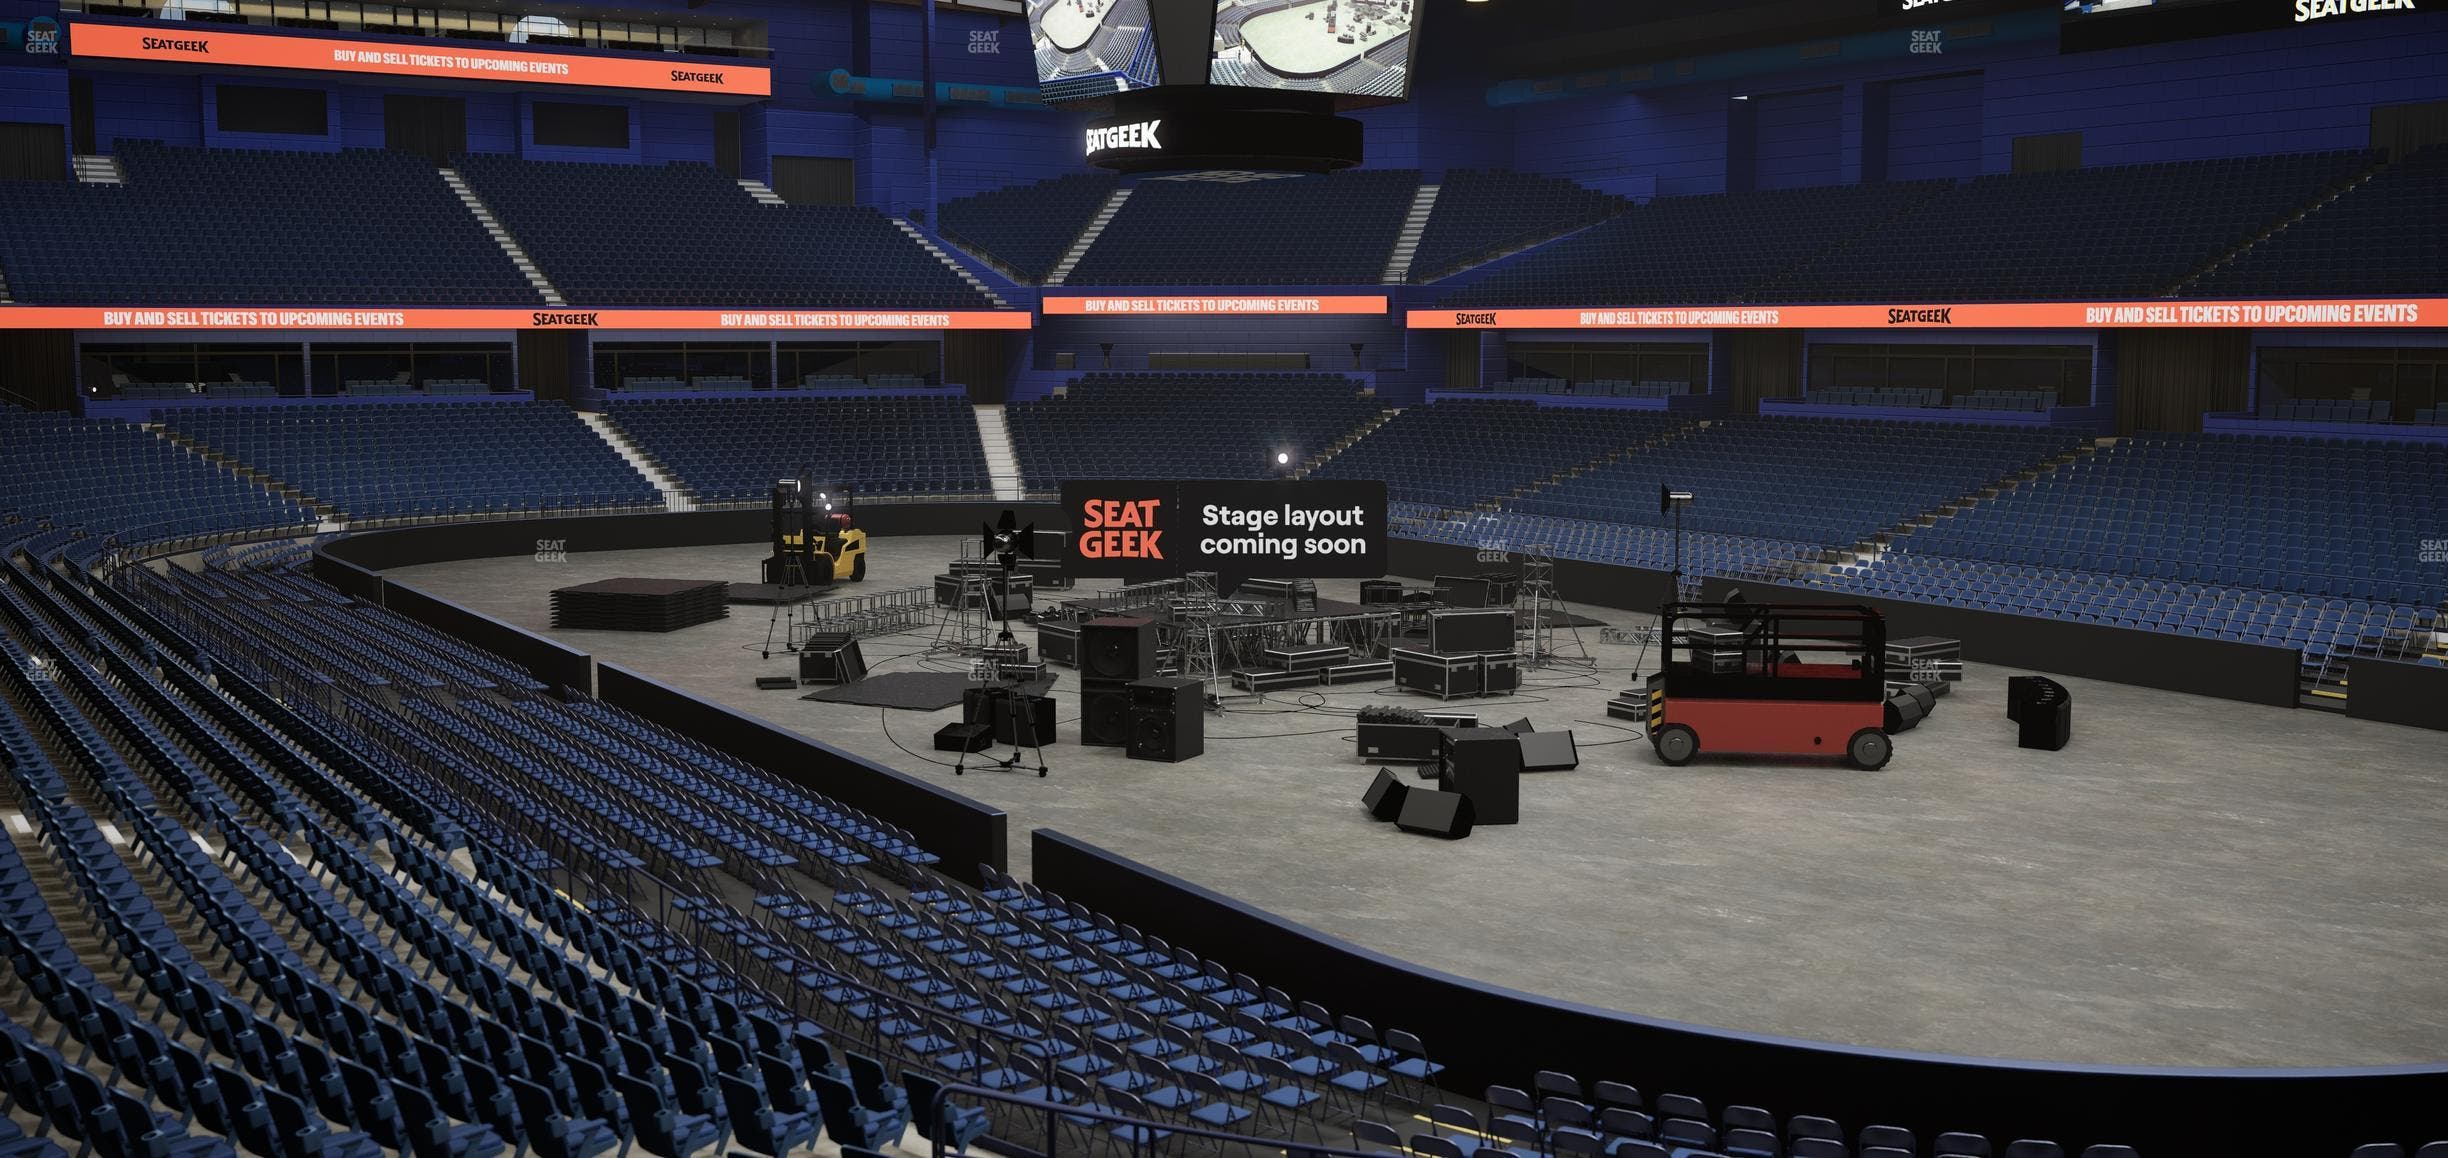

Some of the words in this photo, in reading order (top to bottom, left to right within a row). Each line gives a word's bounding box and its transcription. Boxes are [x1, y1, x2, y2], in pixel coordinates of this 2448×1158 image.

[142, 37, 209, 53] SEATGEEK
[335, 50, 356, 61] BUY
[358, 52, 381, 63] AND
[383, 53, 408, 64] SELL
[409, 54, 453, 67] TICKETS
[455, 57, 469, 68] TO
[471, 58, 528, 72] UPCOMING
[530, 62, 568, 74] EVENTS
[671, 70, 723, 84] SEATGEEK
[1085, 299, 1108, 311] BUY
[1107, 299, 1130, 311] AND
[1131, 299, 1157, 311] SELL
[1156, 299, 1200, 311] TICKETS
[1201, 299, 1216, 311] TO
[1217, 299, 1276, 311] UPCOMING
[1277, 299, 1319, 311] EVENTS
[104, 312, 132, 325] BUY
[135, 312, 164, 325] AND
[167, 312, 199, 325] SELL
[201, 312, 257, 325] TICKETS
[259, 312, 277, 325] TO
[280, 312, 352, 325] UPCOMING
[355, 312, 403, 325] EVENTS
[533, 312, 598, 326] SEATGEEK
[721, 314, 742, 326] BUY
[744, 314, 767, 326] AND
[769, 314, 793, 326] SELL
[794, 314, 838, 326] TICKETS
[839, 314, 853, 326] TO
[854, 314, 910, 326] UPCOMING
[911, 314, 949, 326] EVENTS
[1456, 312, 1496, 325] SEATGEEK
[1580, 312, 1596, 324] BUY
[1597, 312, 1616, 324] AND
[1617, 312, 1637, 324] SELL
[1636, 311, 1674, 324] TICKETS
[1675, 311, 1687, 324] TO
[1688, 311, 1740, 324] UPCOMING
[1741, 310, 1778, 324] EVENTS
[1888, 308, 1951, 324] SEATGEEK
[2086, 307, 2113, 323] BUY
[2114, 307, 2144, 322] AND
[2146, 307, 2177, 322] SELL
[2180, 306, 2240, 322] TICKETS
[2242, 305, 2262, 322] TO
[2265, 305, 2351, 322] UPCOMING
[2354, 304, 2417, 322] EVENTS
[1083, 499, 1160, 528] SEAT
[1202, 504, 1278, 531] Stage
[1285, 504, 1363, 531] layout
[1079, 530, 1163, 560] GEEK
[1200, 532, 1297, 560] coming
[1304, 537, 1366, 554] soon
